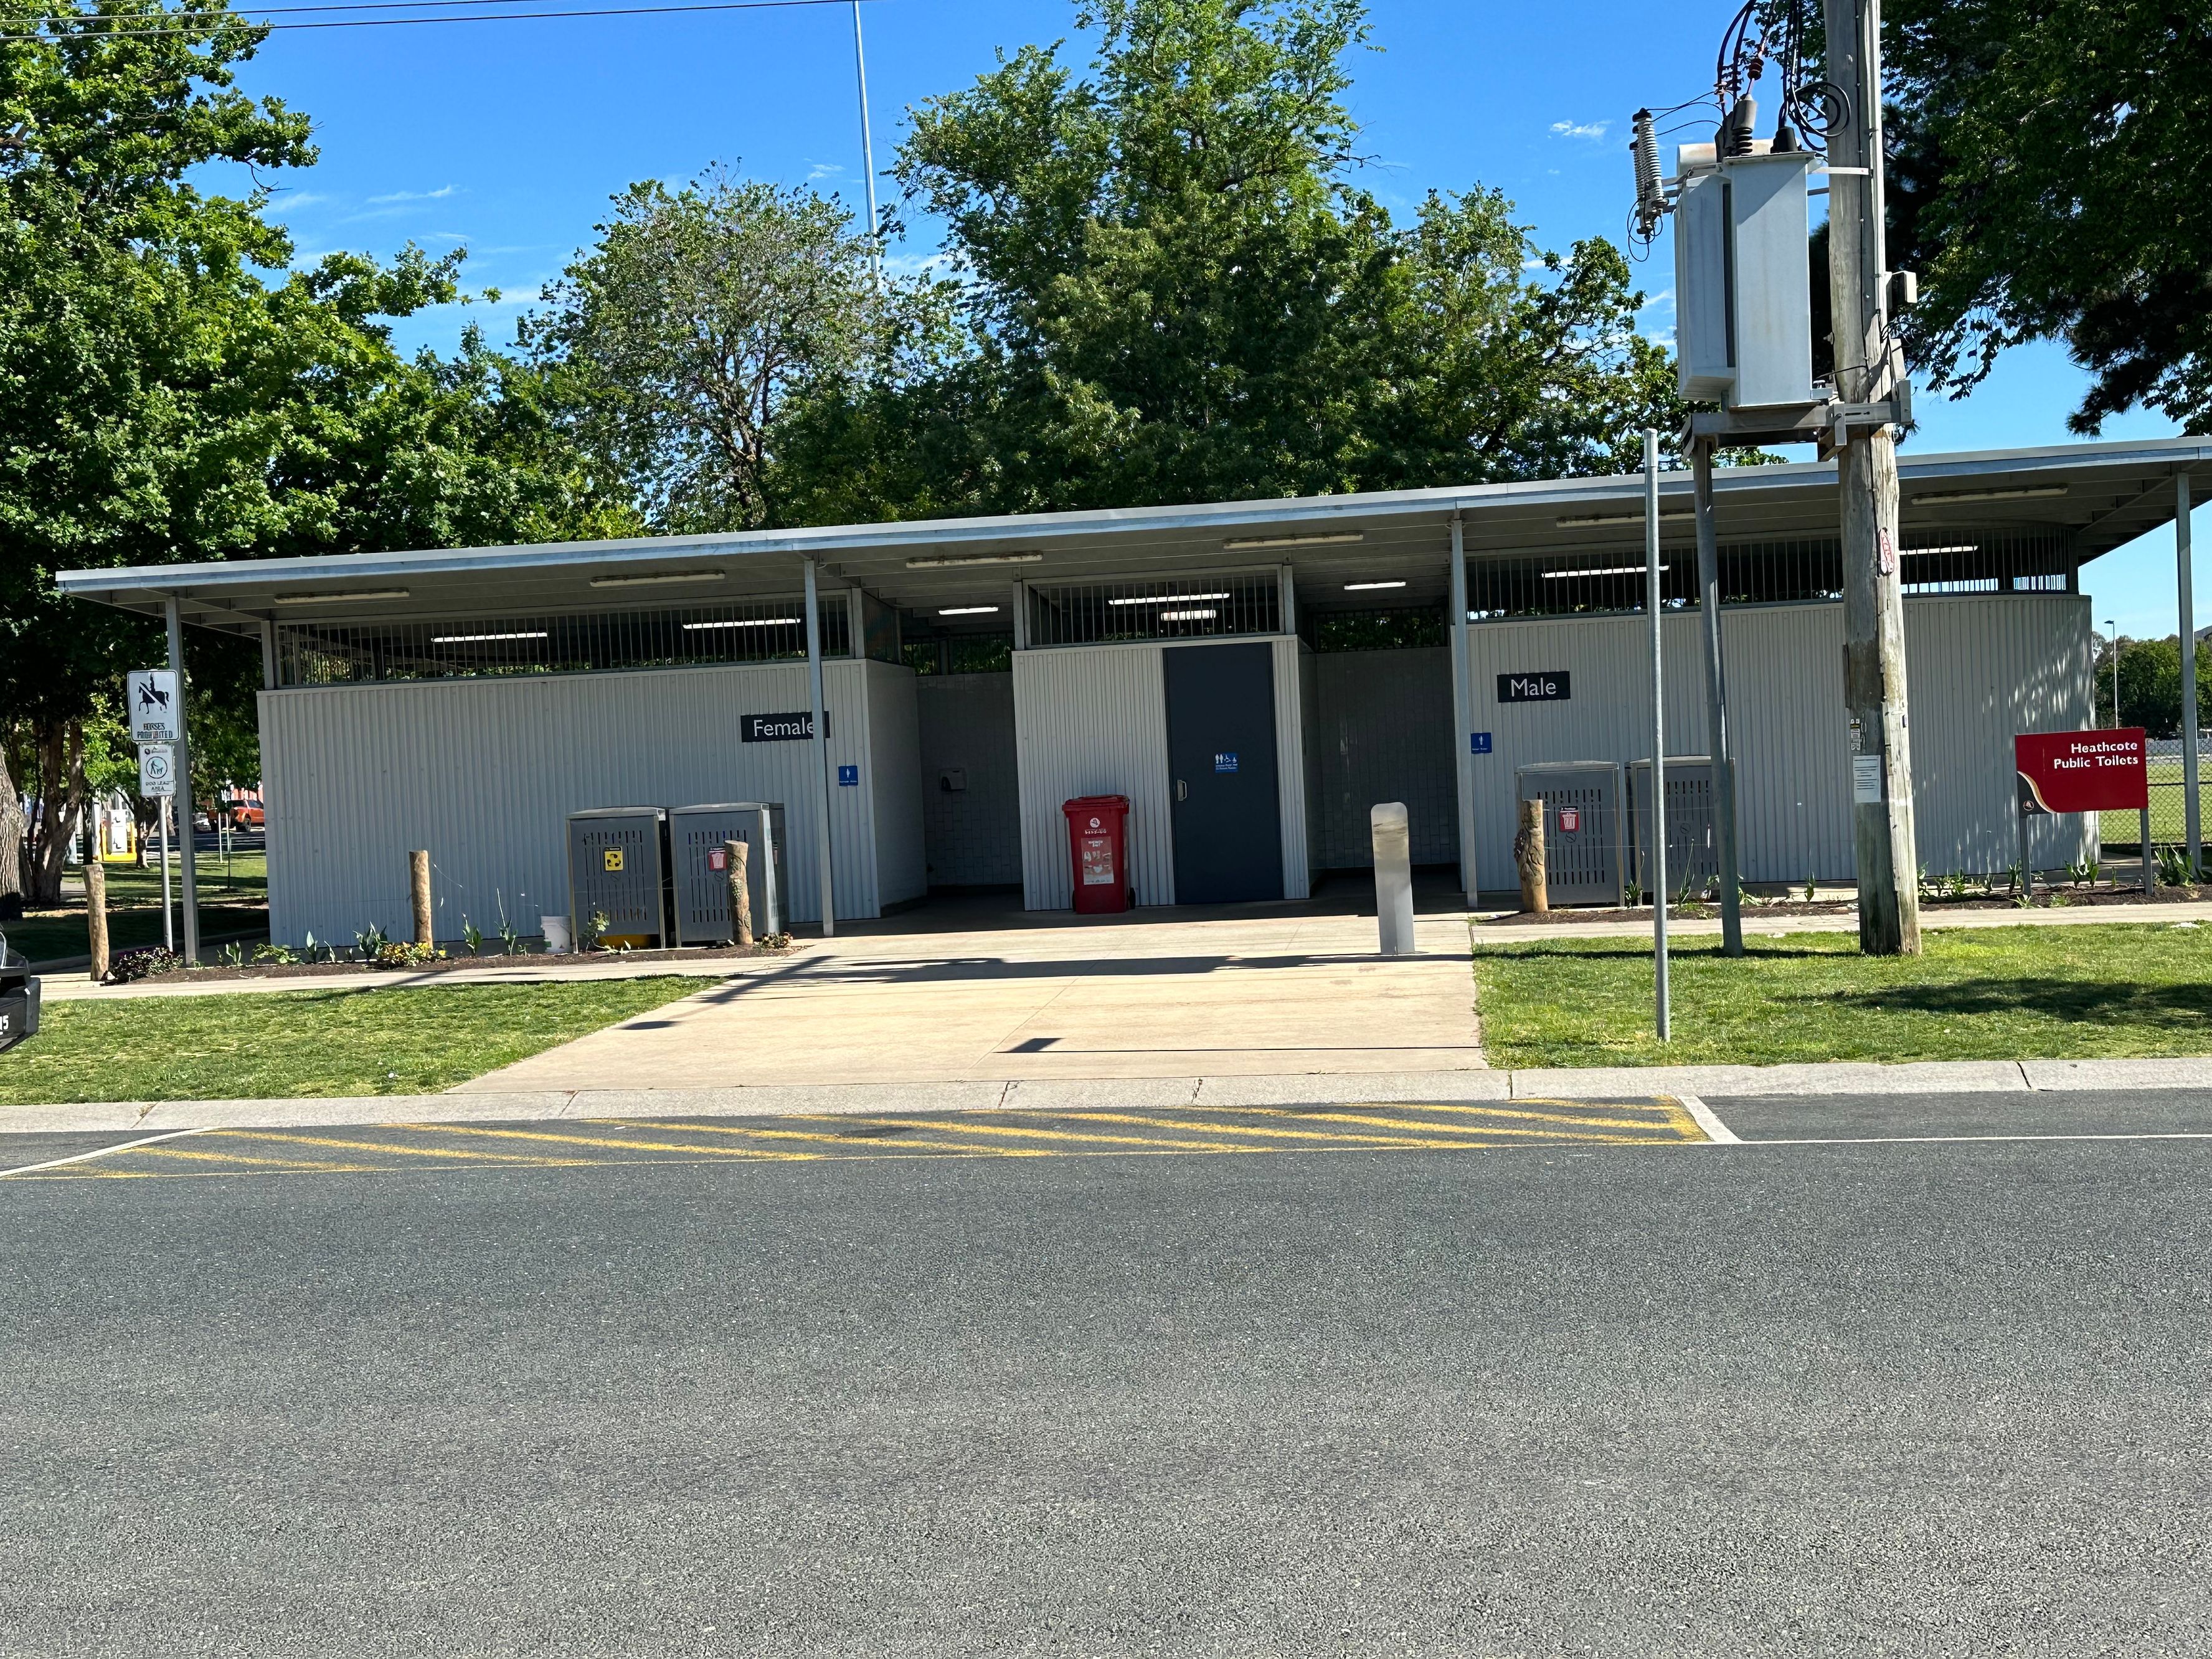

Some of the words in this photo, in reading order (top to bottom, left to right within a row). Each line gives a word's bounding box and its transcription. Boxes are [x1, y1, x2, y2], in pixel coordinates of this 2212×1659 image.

[1511, 678, 1556, 697] Male
[754, 717, 813, 737] Female
[2071, 742, 2138, 754] Heathcote
[2054, 757, 2091, 769] Public
[2095, 755, 2139, 767] Toilets
